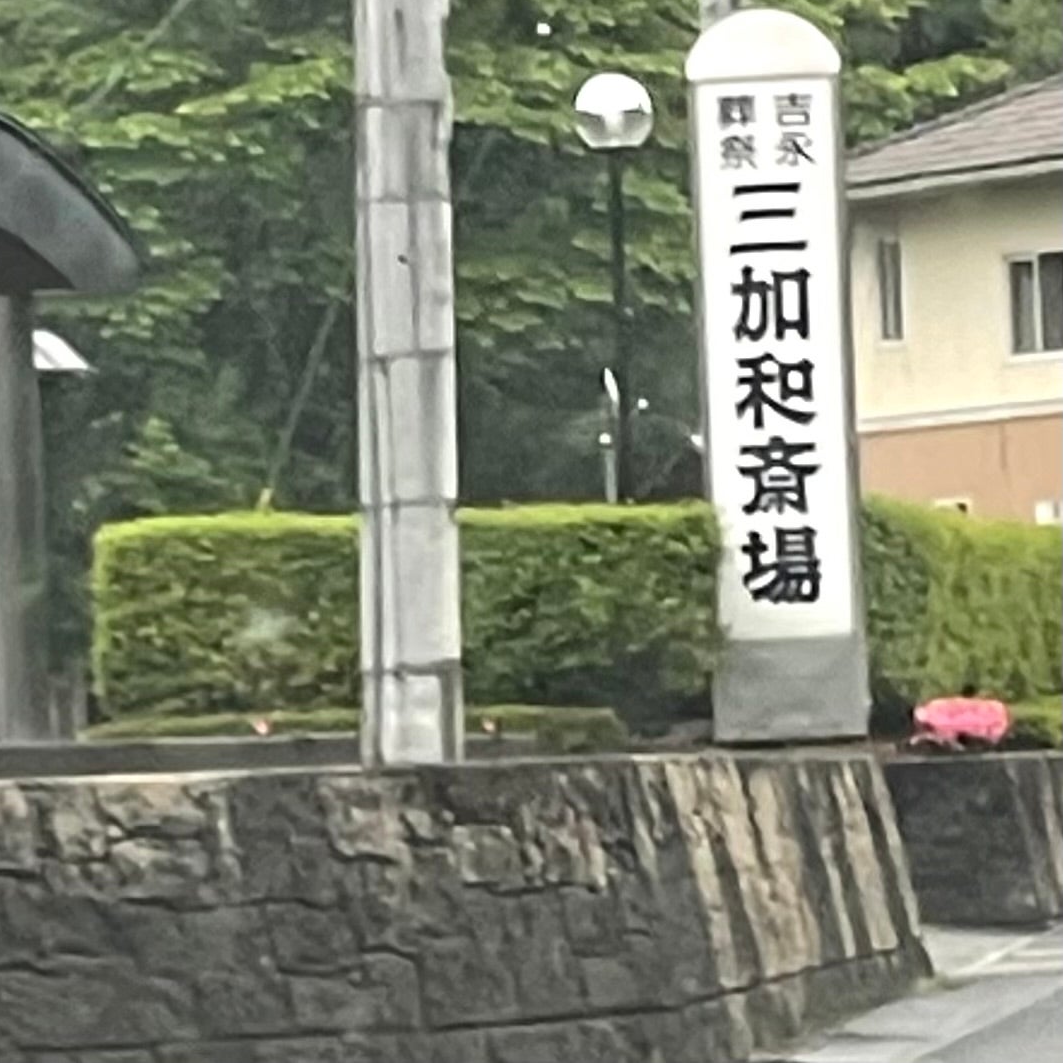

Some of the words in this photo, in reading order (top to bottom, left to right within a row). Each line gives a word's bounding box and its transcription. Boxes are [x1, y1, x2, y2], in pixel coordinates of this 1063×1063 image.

[730, 182, 821, 604] 三加和斎場
